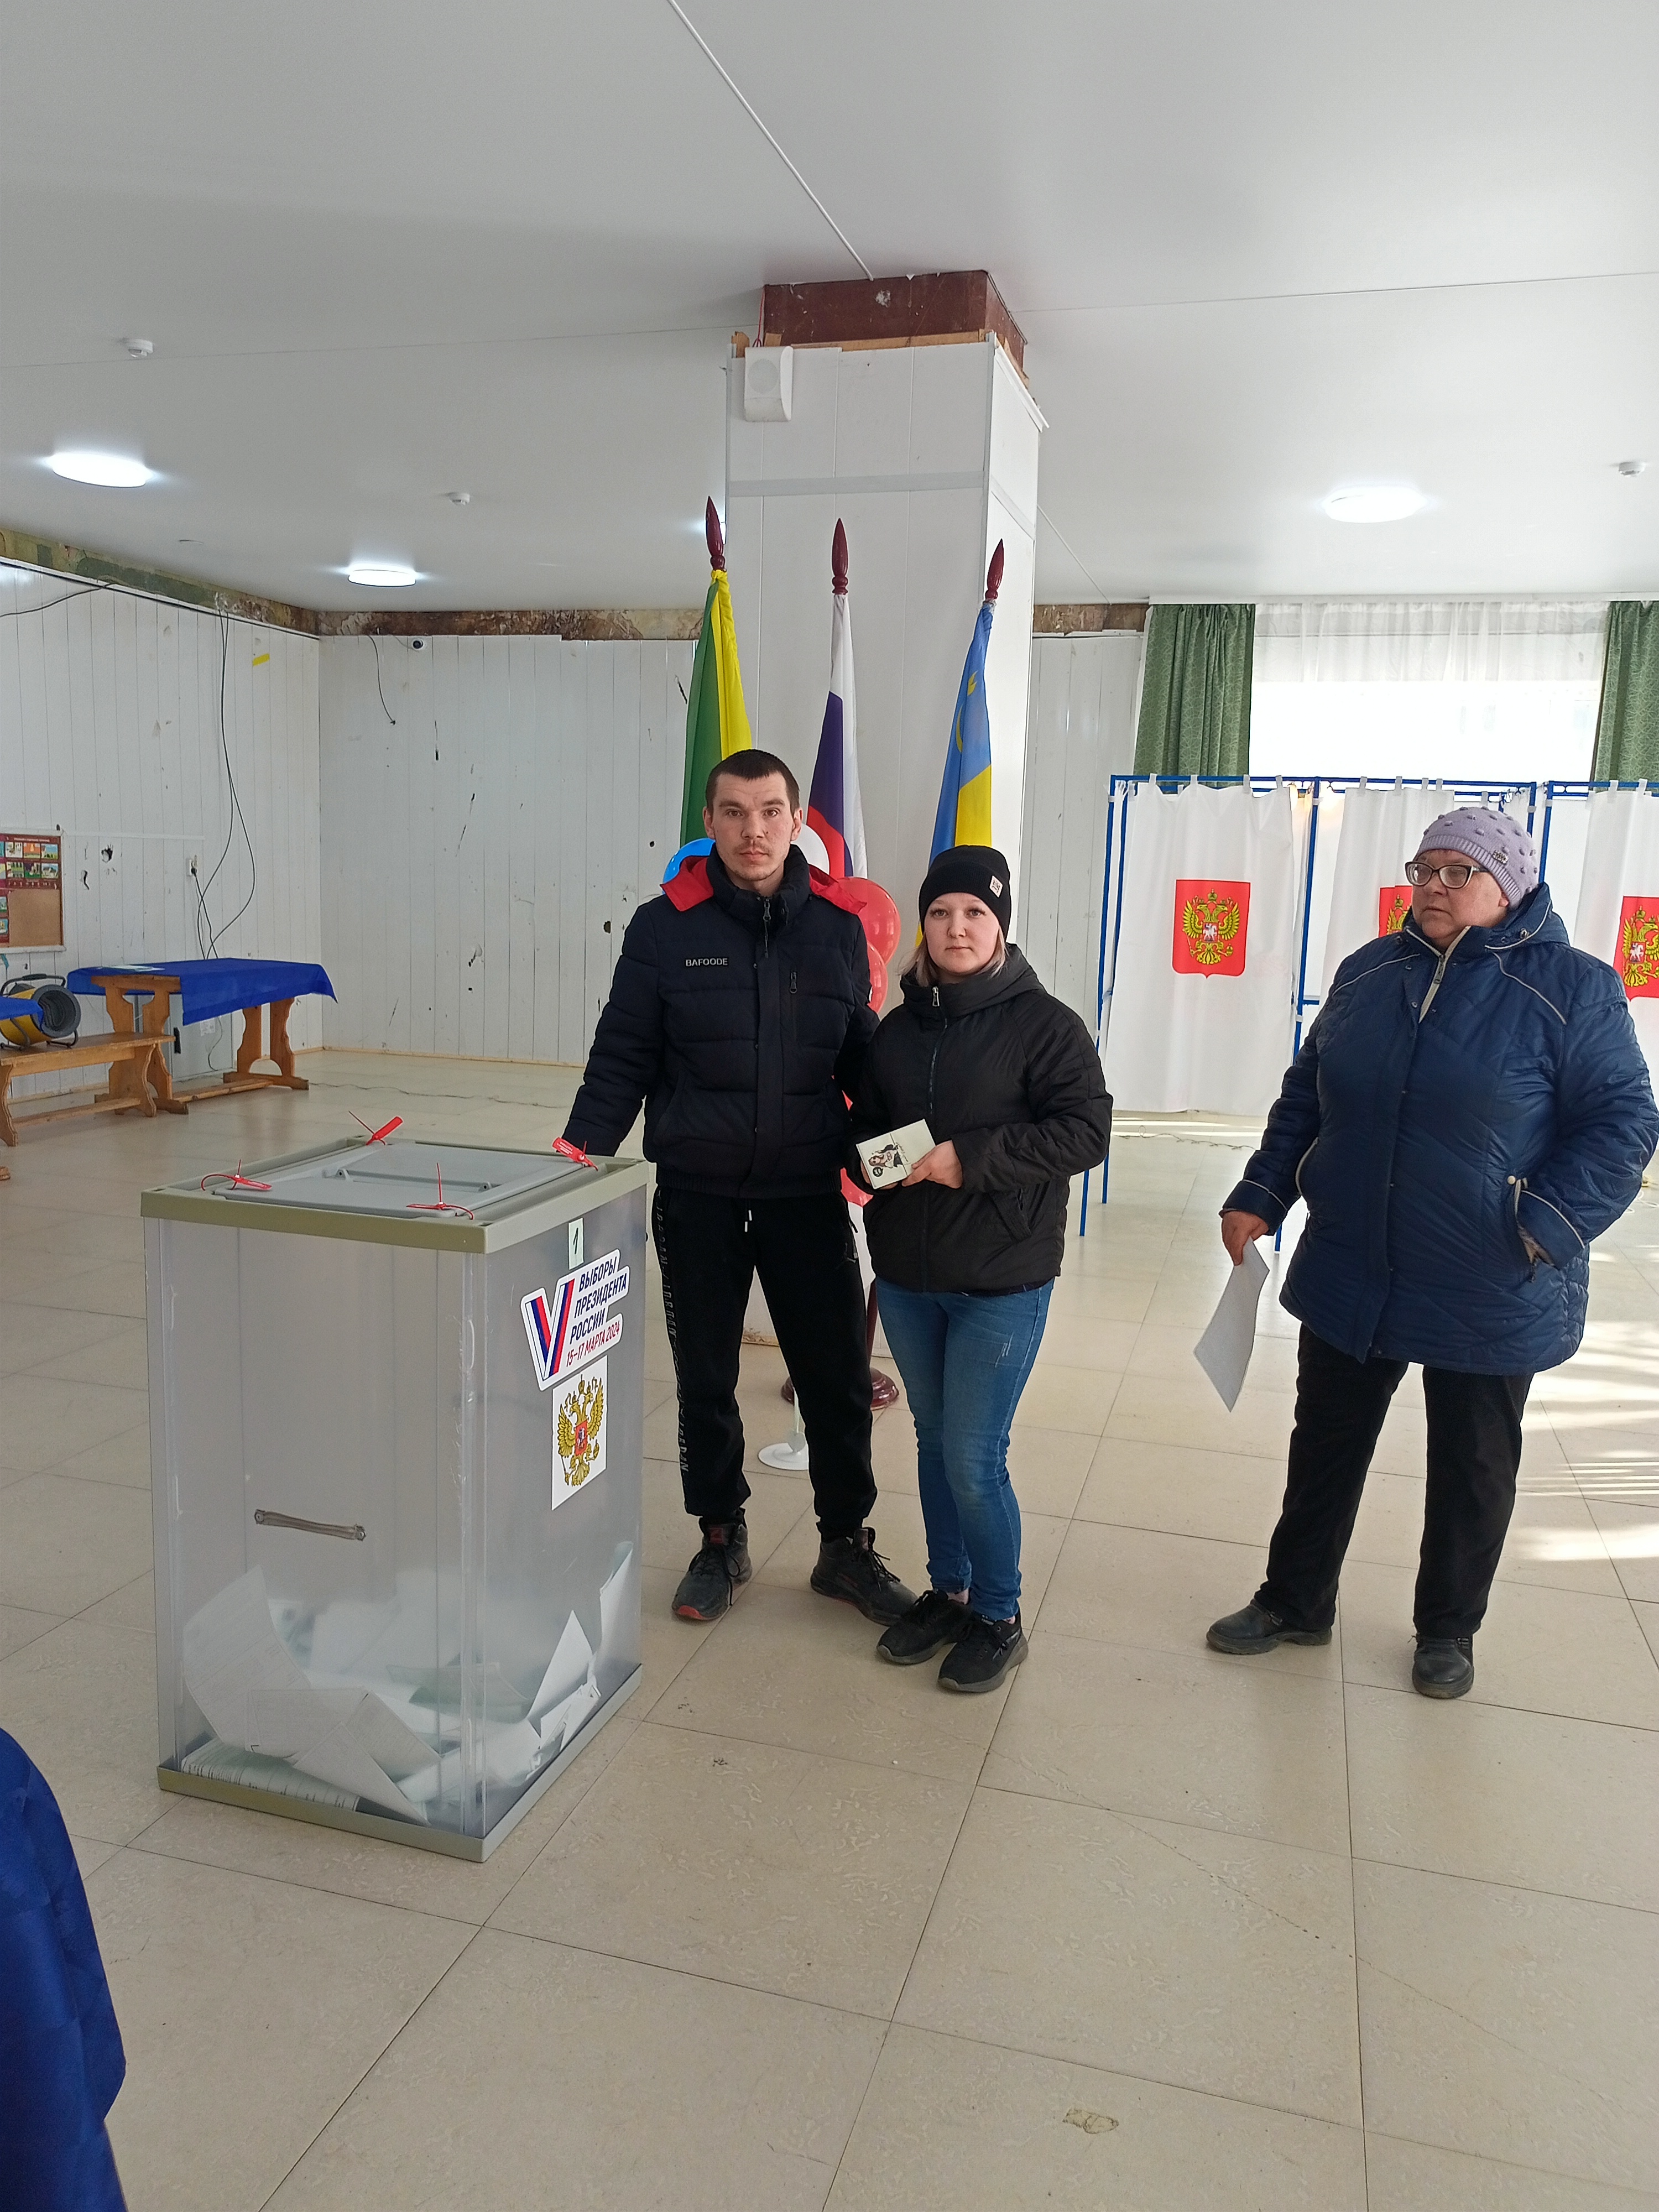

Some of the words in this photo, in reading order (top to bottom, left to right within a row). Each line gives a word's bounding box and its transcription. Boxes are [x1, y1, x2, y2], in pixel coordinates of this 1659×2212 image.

[686, 958, 728, 967] BAFOODE
[573, 1227, 578, 1255] 1
[578, 1256, 617, 1292] ВЫБОРЫ
[574, 1273, 627, 1318] ПРЕЗИДЕНТА
[570, 1308, 606, 1344] РОССИИ
[585, 1329, 606, 1355] МАРТА
[606, 1321, 620, 1343] 2024
